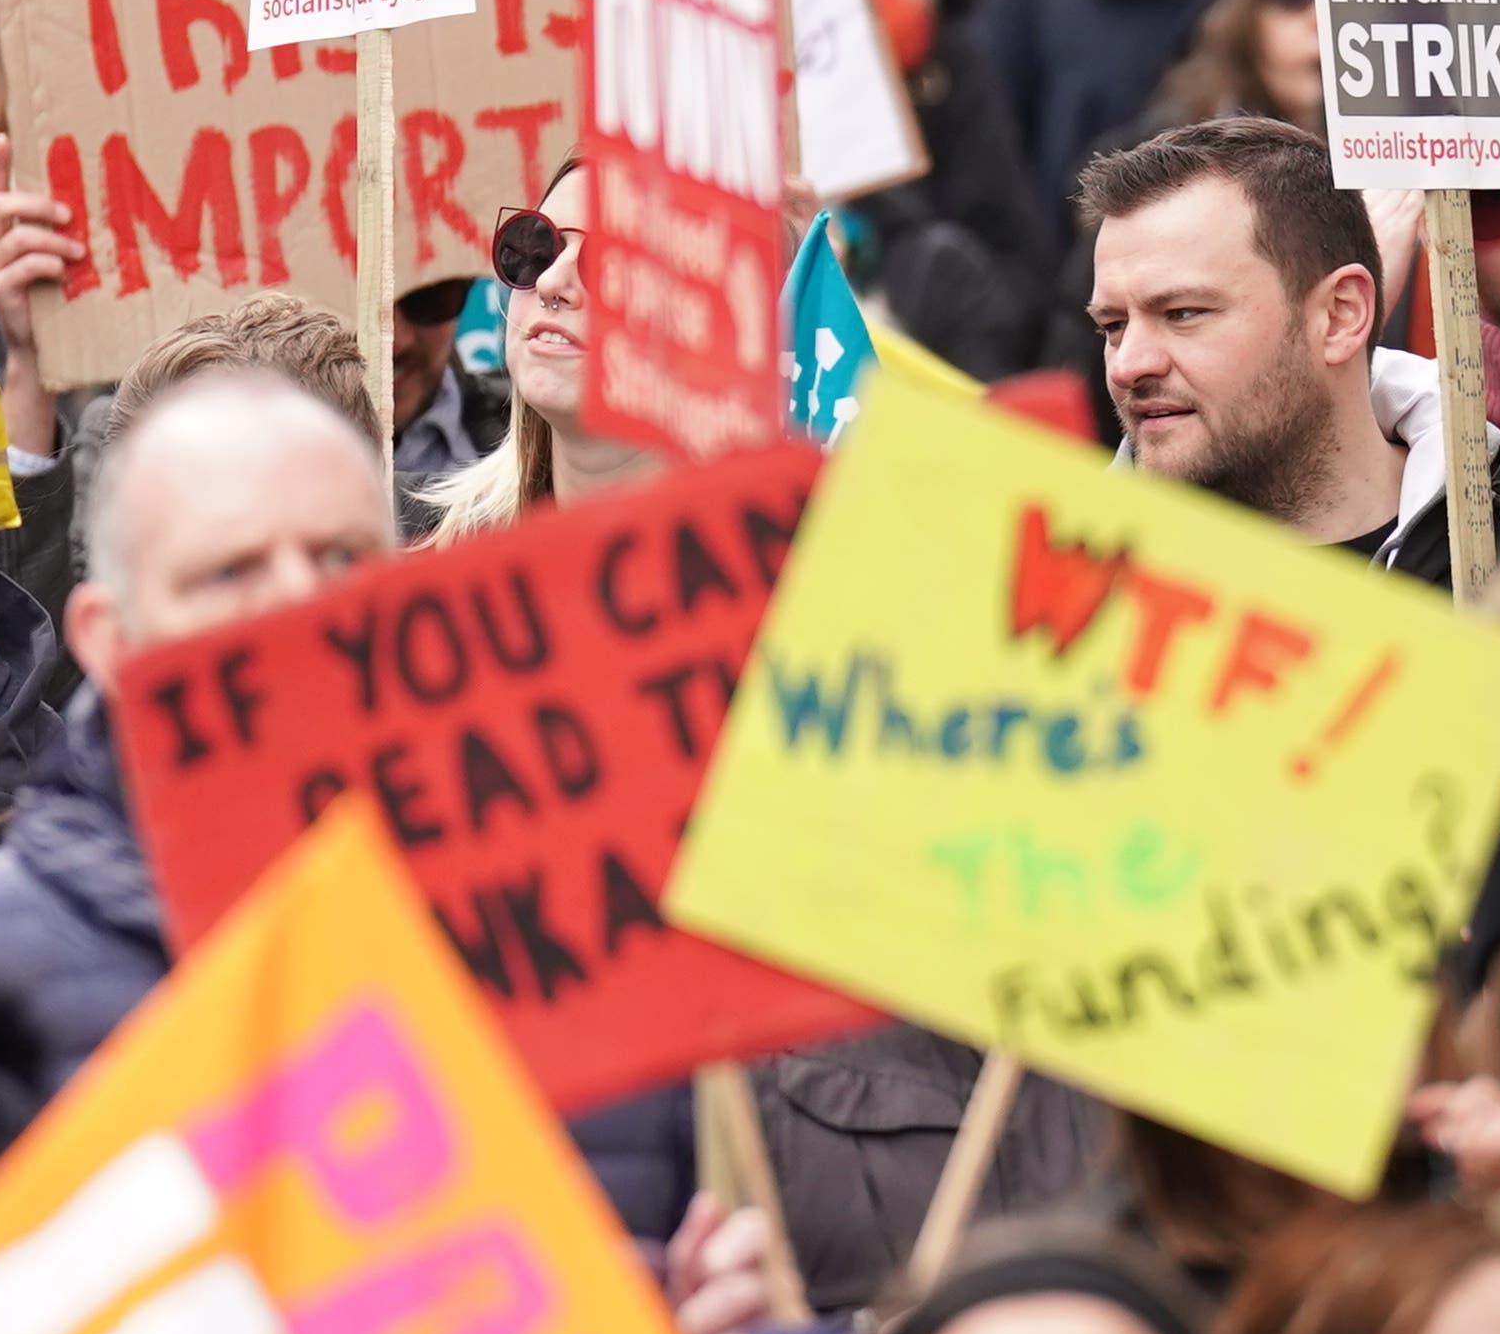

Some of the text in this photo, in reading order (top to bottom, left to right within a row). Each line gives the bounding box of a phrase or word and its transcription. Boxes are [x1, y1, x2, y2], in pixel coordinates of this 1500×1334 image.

[147, 647, 268, 775] IF
[324, 571, 552, 717] YOU
[1009, 495, 1406, 782] WTF!
[927, 817, 1208, 939] The
